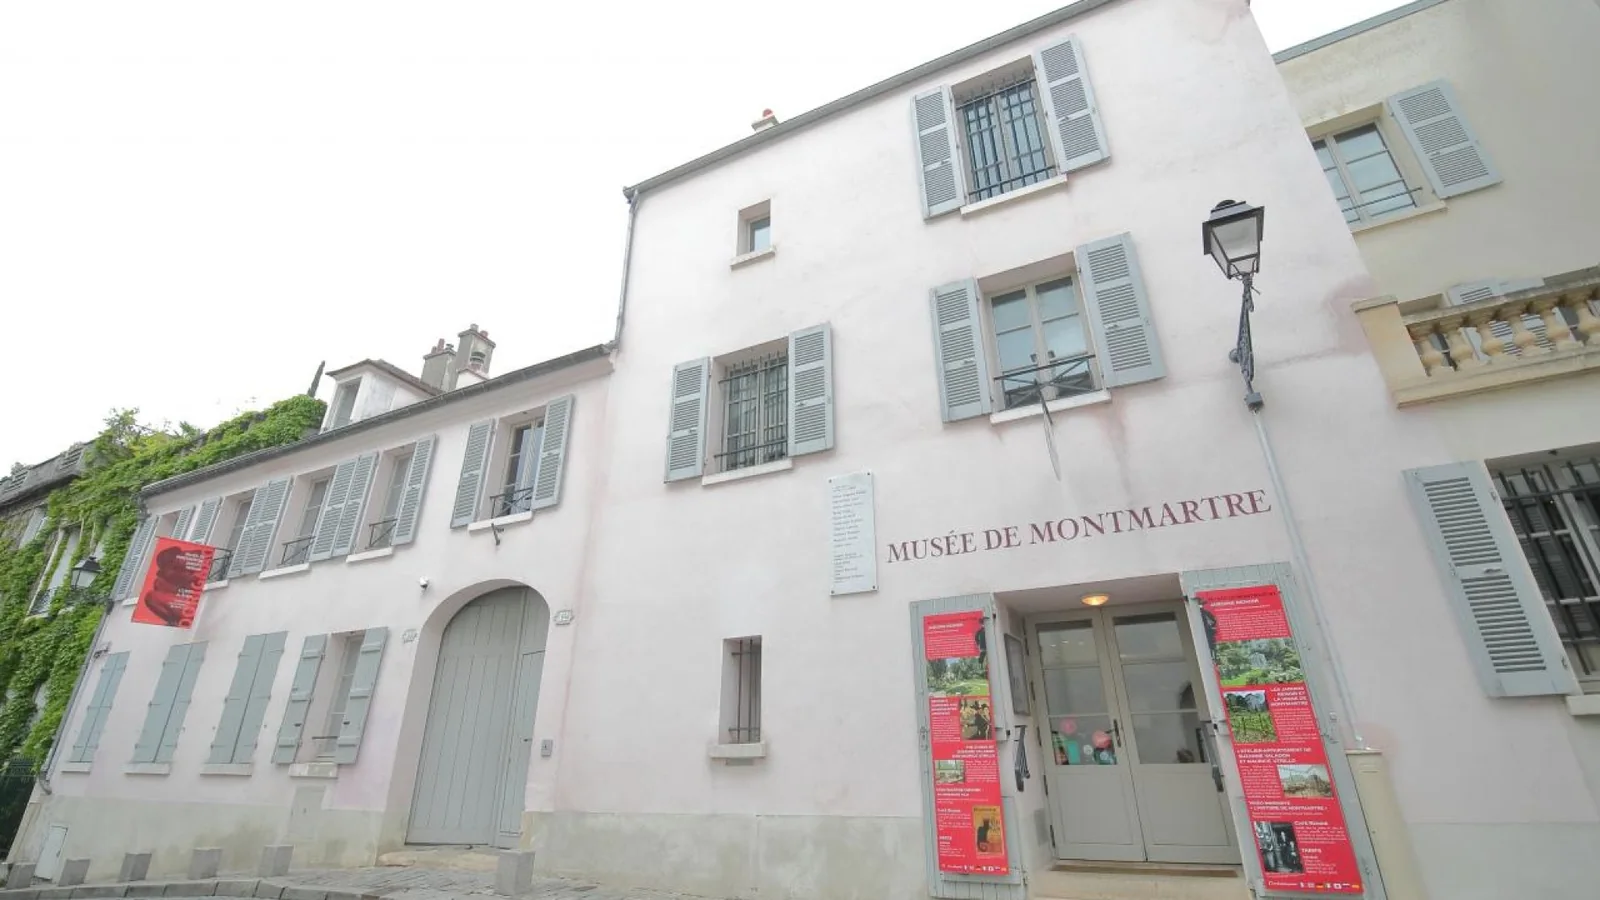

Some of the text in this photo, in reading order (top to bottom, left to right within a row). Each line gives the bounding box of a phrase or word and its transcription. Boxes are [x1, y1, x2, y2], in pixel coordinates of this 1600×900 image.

[886, 489, 1272, 563] MUSÉE DE MONTMARTRE
